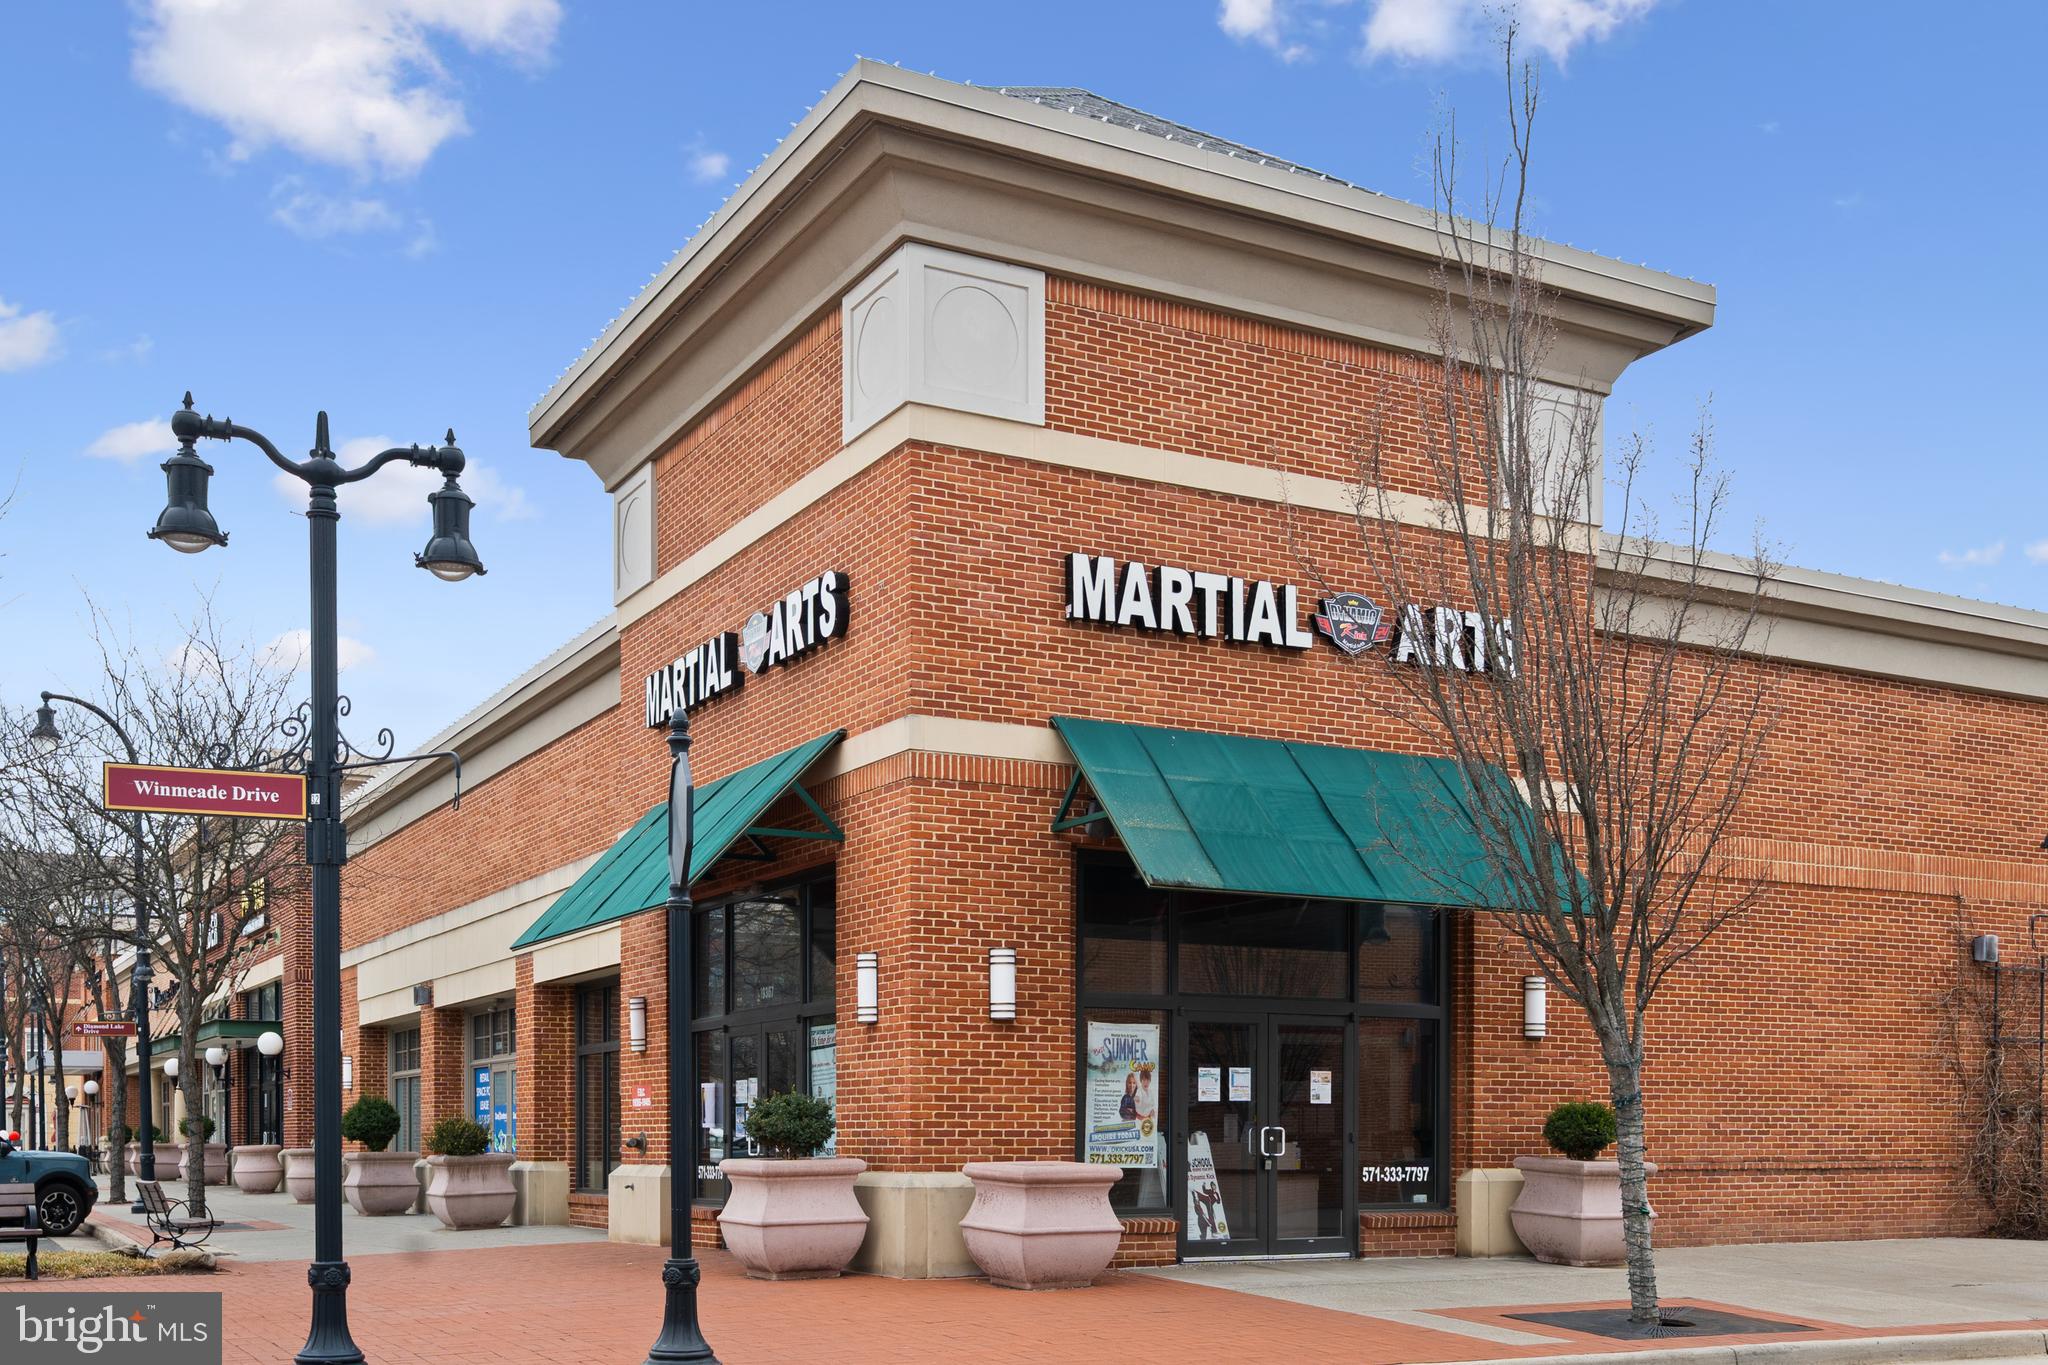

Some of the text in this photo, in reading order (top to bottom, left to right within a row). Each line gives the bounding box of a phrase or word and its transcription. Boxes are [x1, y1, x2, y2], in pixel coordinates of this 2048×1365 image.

[1068, 552, 1313, 650] MARTIAL
[1330, 604, 1377, 625] DYNAMIC
[645, 570, 842, 728] MARTIAL ARTS
[133, 780, 280, 803] Winmeade Drive
[1102, 1037, 1148, 1061] SUMMER
[1089, 1154, 1144, 1164] 571.333.7797
[1362, 1166, 1430, 1182] 571-333-7797
